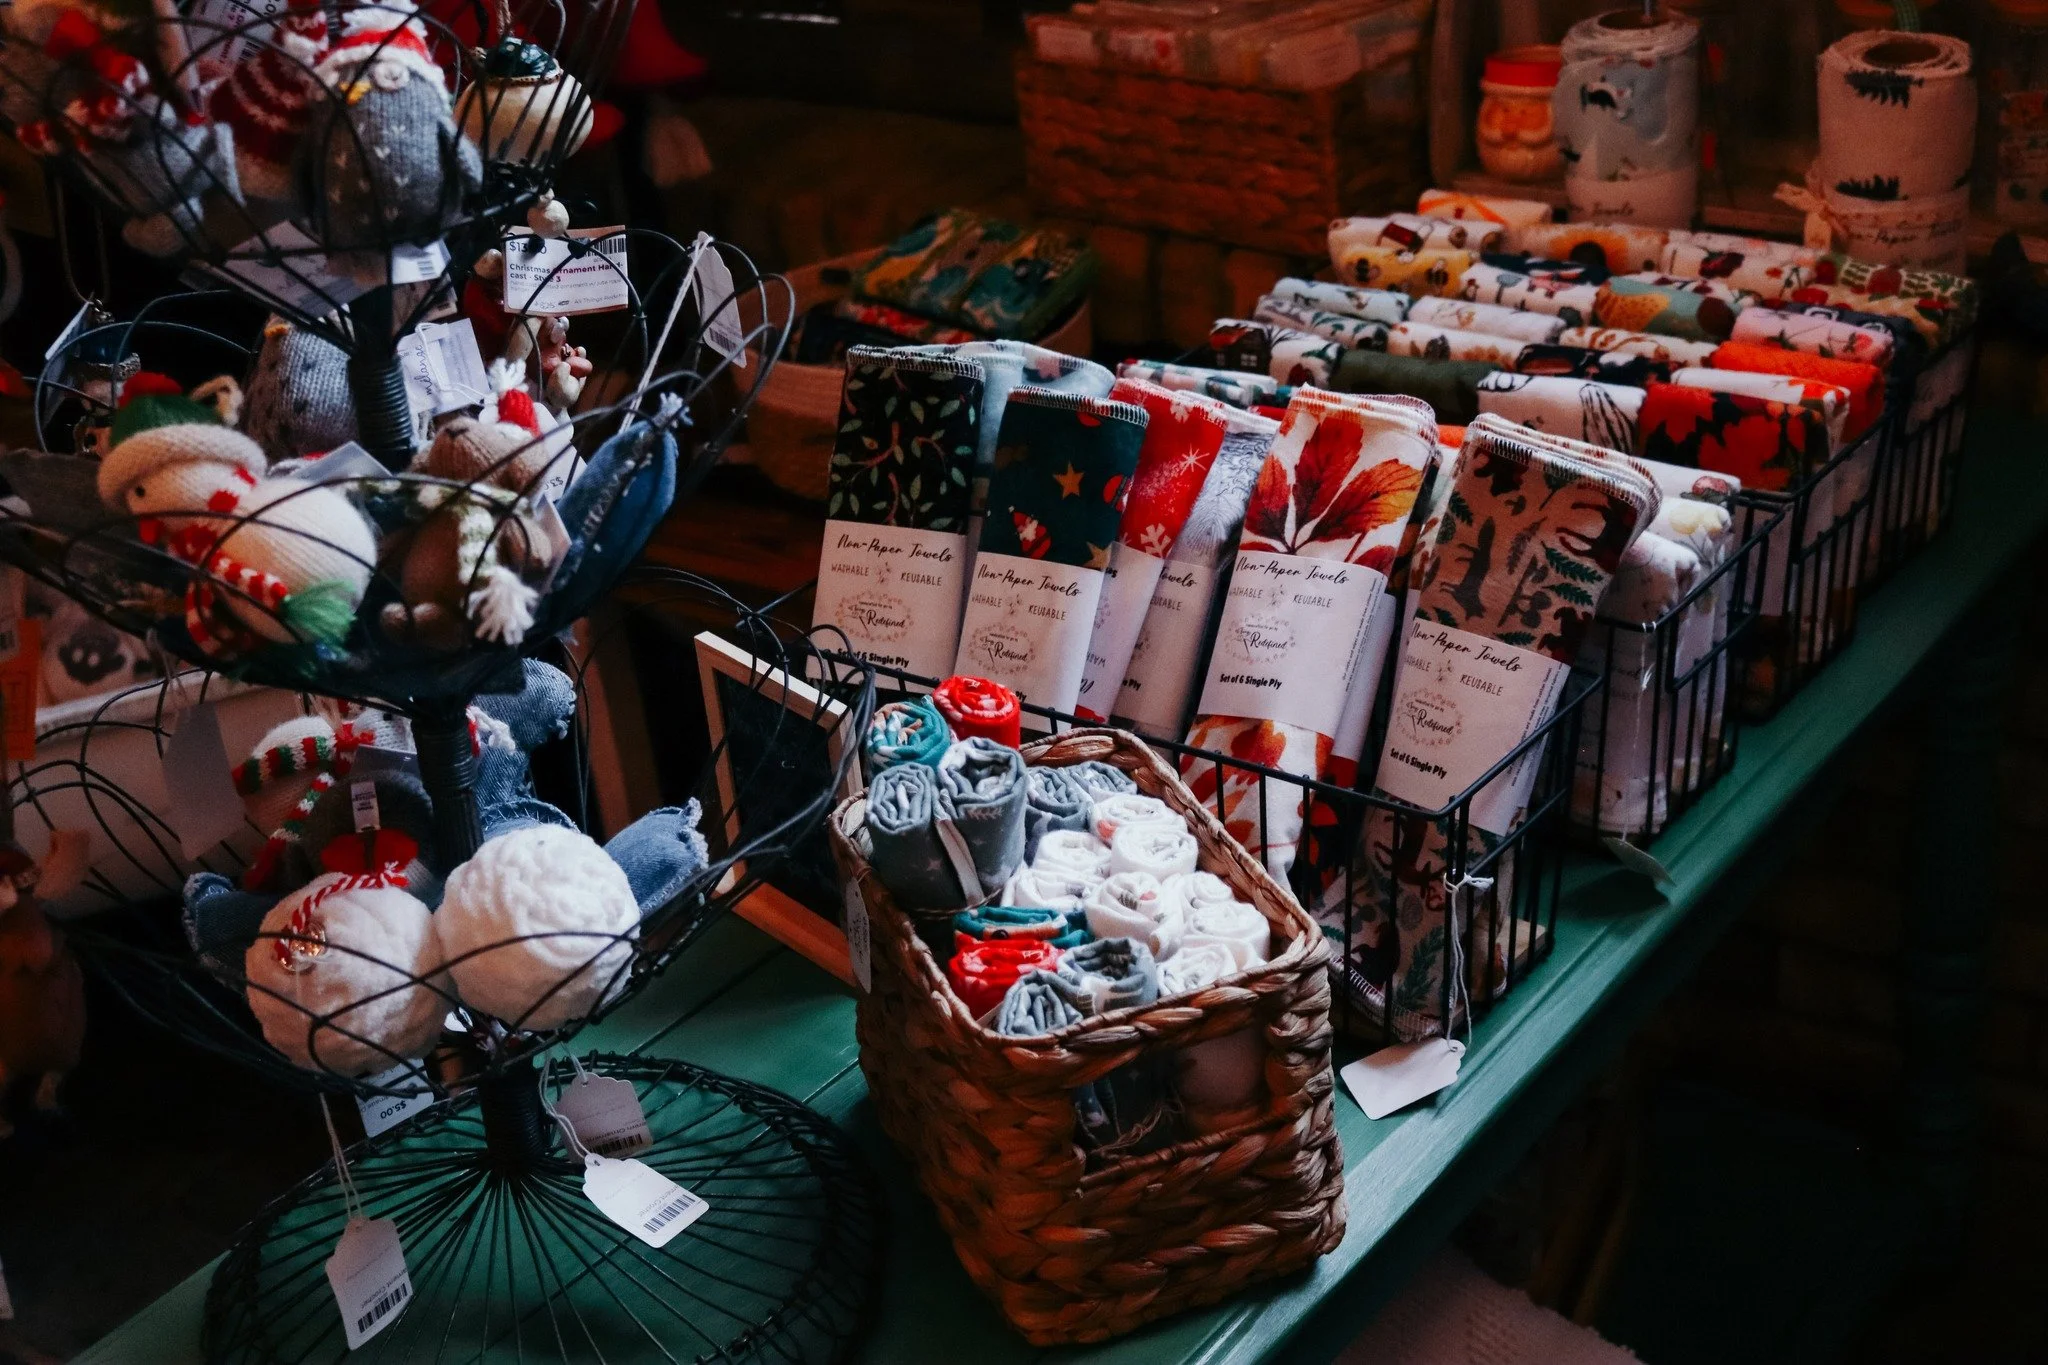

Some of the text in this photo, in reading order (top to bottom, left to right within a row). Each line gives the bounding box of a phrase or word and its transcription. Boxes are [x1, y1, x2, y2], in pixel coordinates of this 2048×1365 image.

[510, 241, 547, 254] $130
[510, 263, 551, 274] Christmas
[553, 265, 596, 275] rnament
[534, 274, 554, 283] Stye
[837, 533, 954, 562] Non-Paper Towels
[831, 563, 869, 576] WASHABLE
[1236, 556, 1349, 585] Non-Paper Towels
[900, 572, 942, 586] REUSABLE
[978, 563, 1082, 596] Non-Paper Towels
[1293, 594, 1333, 608] REUSABLE
[866, 609, 905, 628] Redefined
[1028, 604, 1067, 620] REUSABLE
[1250, 631, 1287, 649] Redefined
[1411, 622, 1522, 671] Non-Paper Towels
[869, 652, 895, 665] Single
[896, 656, 909, 668] Ply
[994, 641, 1028, 661] Redefined
[1220, 673, 1282, 690] Set of 6 Single Ply
[1460, 674, 1503, 696] REUSABLE
[1417, 708, 1454, 735] Redefined
[1390, 748, 1399, 758] Set
[1399, 753, 1406, 762] of
[1410, 756, 1432, 772] Single
[1432, 764, 1447, 779] Ply
[380, 1100, 407, 1119] $5.00
